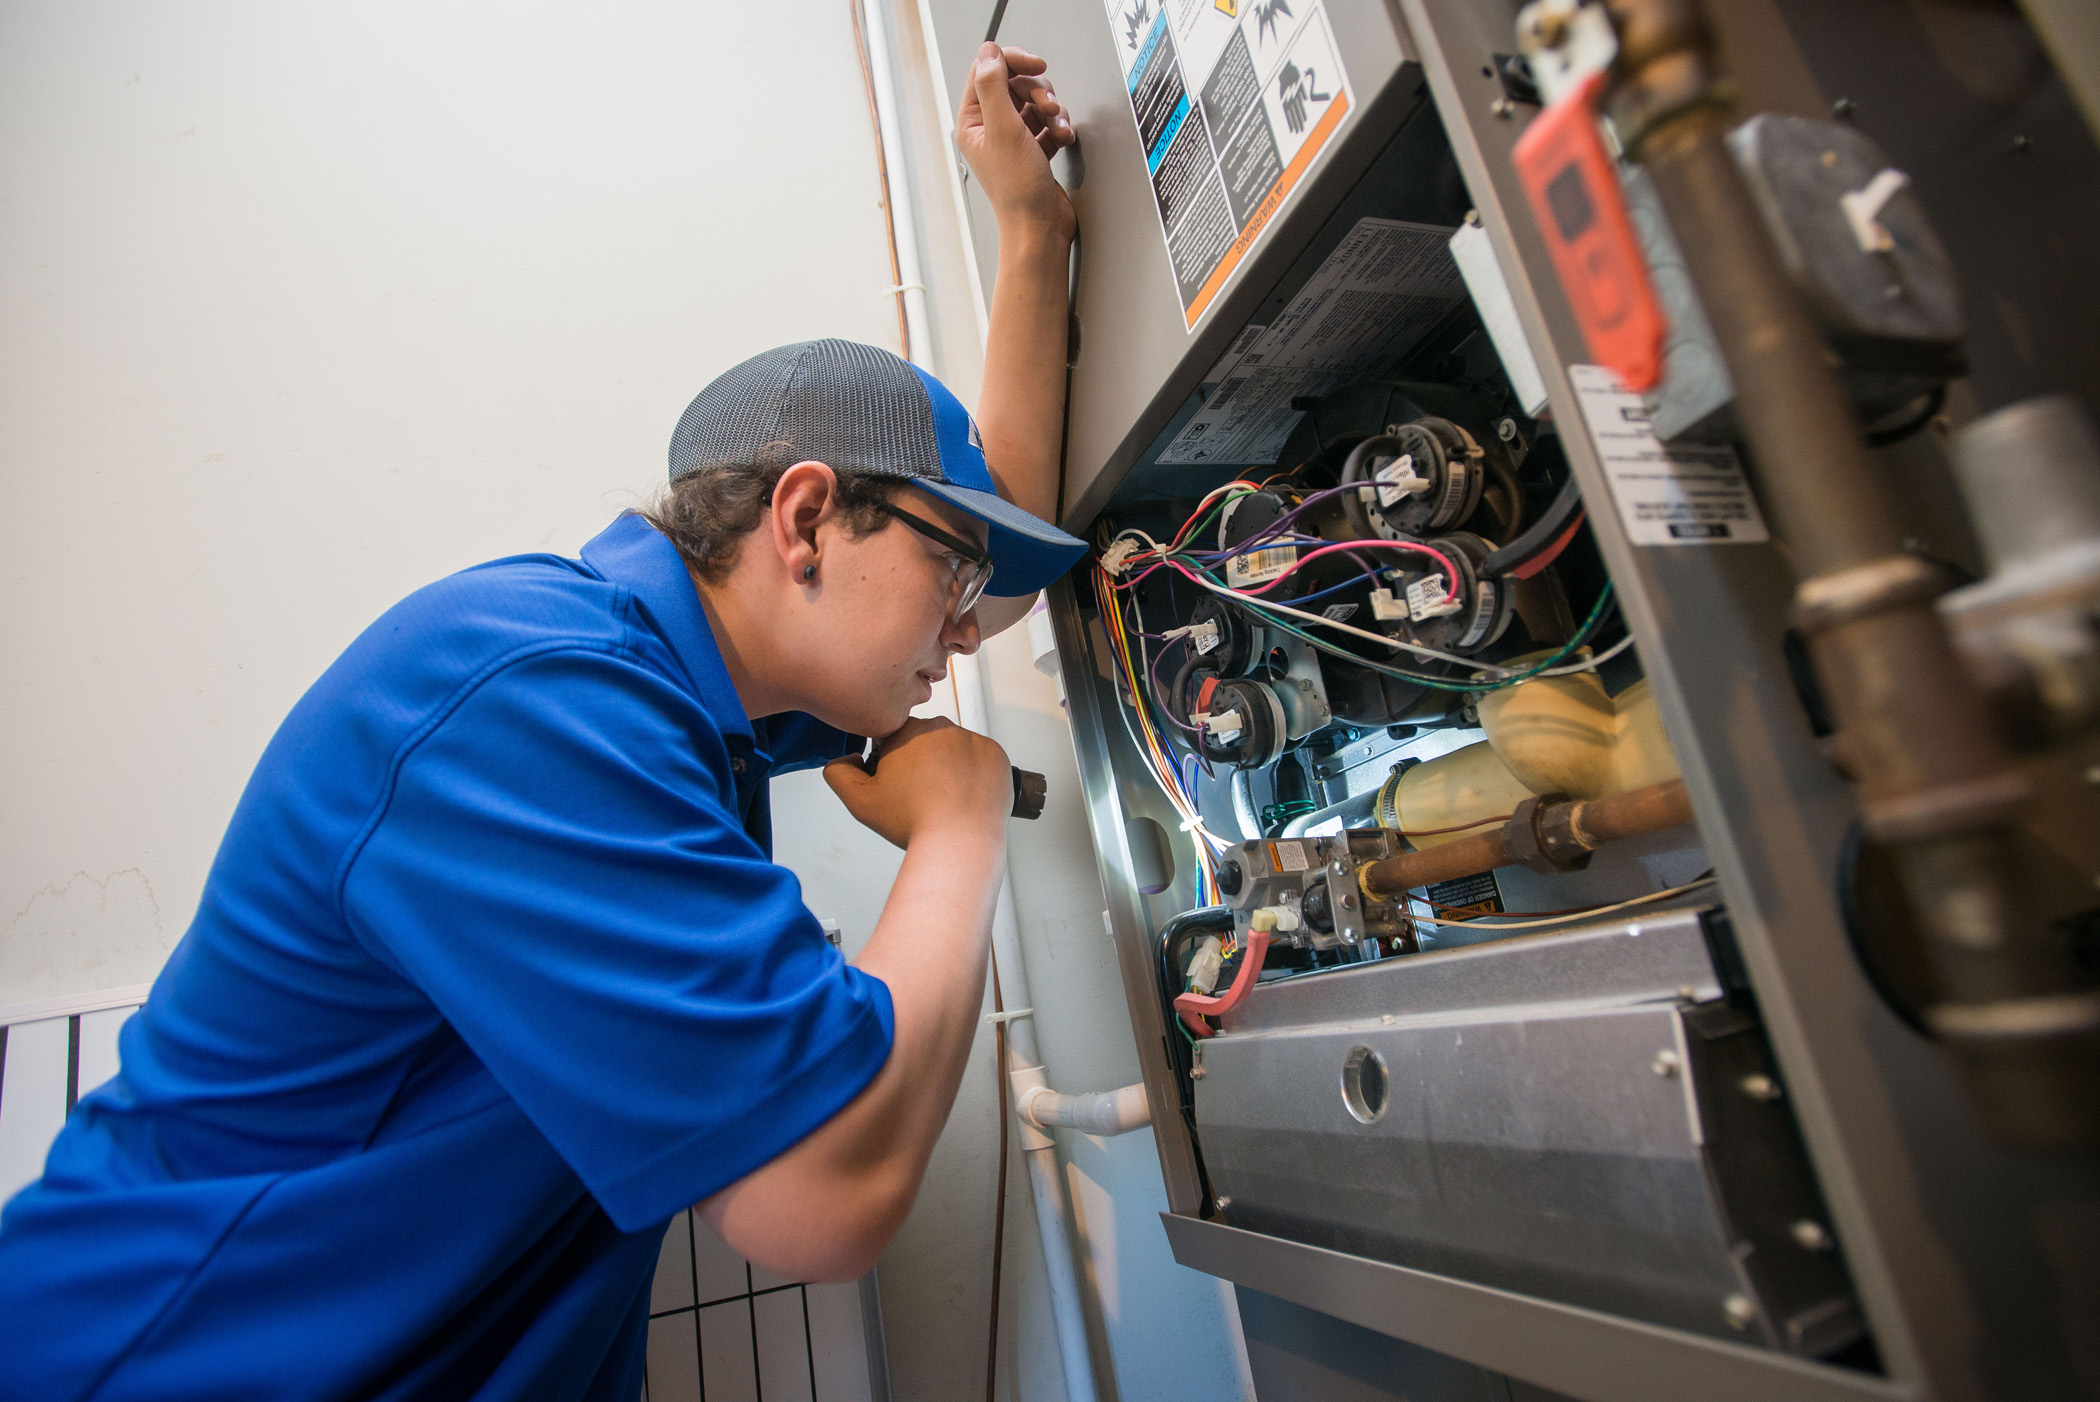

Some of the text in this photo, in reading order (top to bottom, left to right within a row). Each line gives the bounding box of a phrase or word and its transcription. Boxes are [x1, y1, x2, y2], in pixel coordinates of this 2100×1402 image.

[1134, 26, 1159, 78] NOTICE
[1155, 110, 1182, 160] NOTICE
[1236, 196, 1278, 254] WARNING
[1337, 228, 1374, 264] LENNOX
[1447, 905, 1482, 920] WANING
[1474, 890, 1497, 900] DANGER
